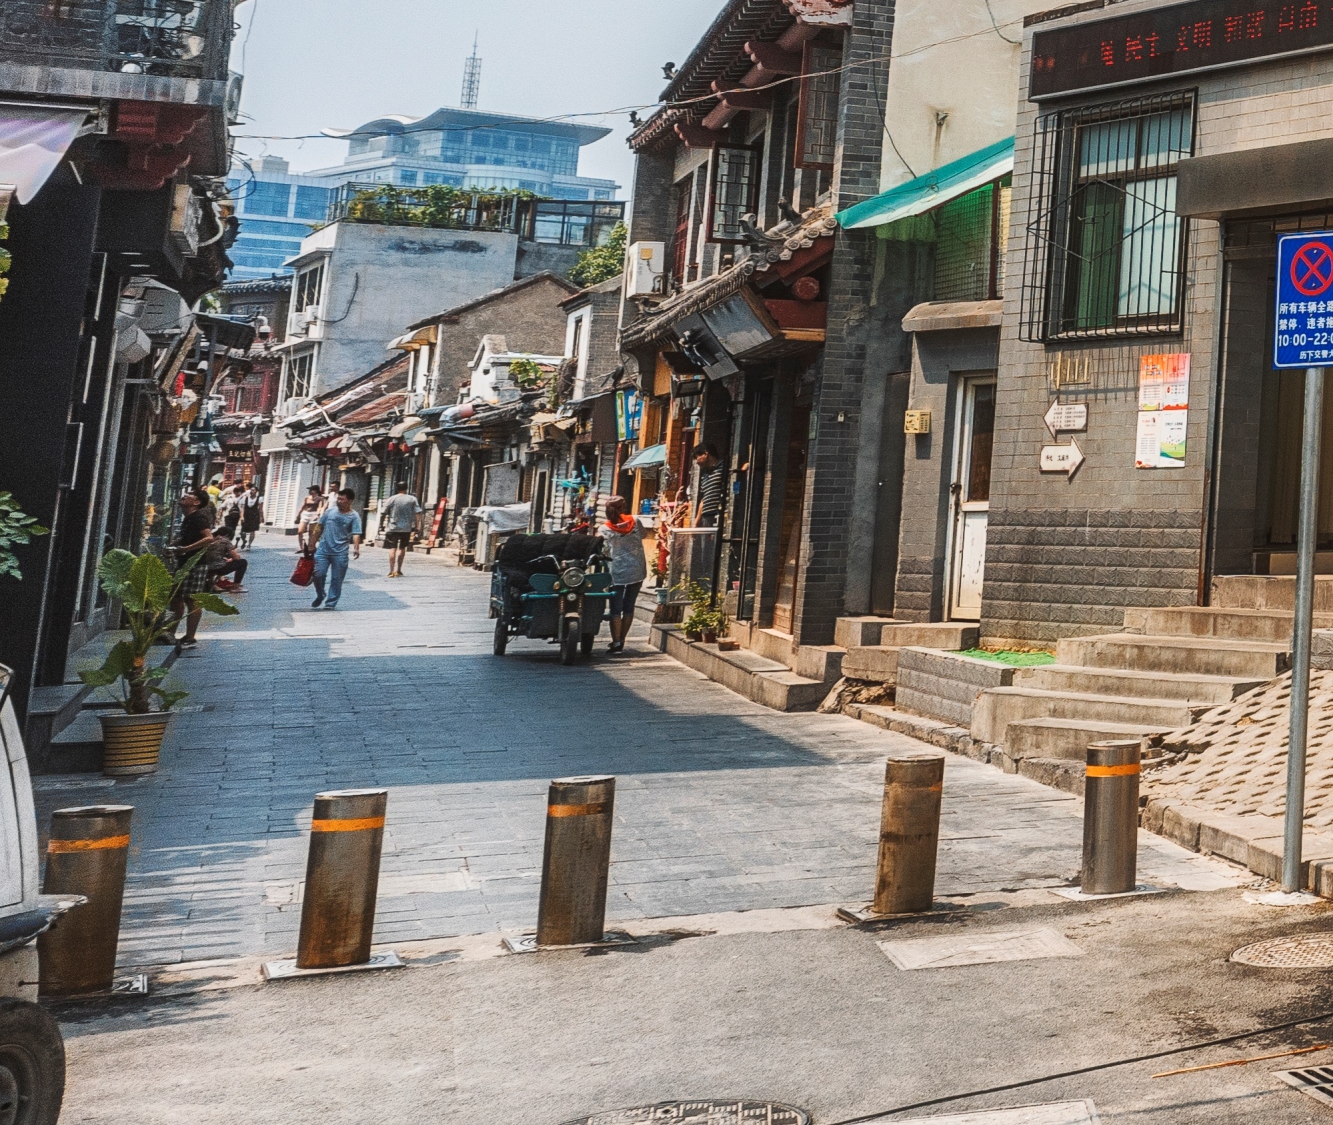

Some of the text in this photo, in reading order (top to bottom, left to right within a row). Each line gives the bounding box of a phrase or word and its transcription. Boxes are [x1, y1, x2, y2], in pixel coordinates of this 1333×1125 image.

[1177, 21, 1211, 52] 文明
[1226, 11, 1265, 42] 和谐
[1279, 1, 1317, 33] 自由
